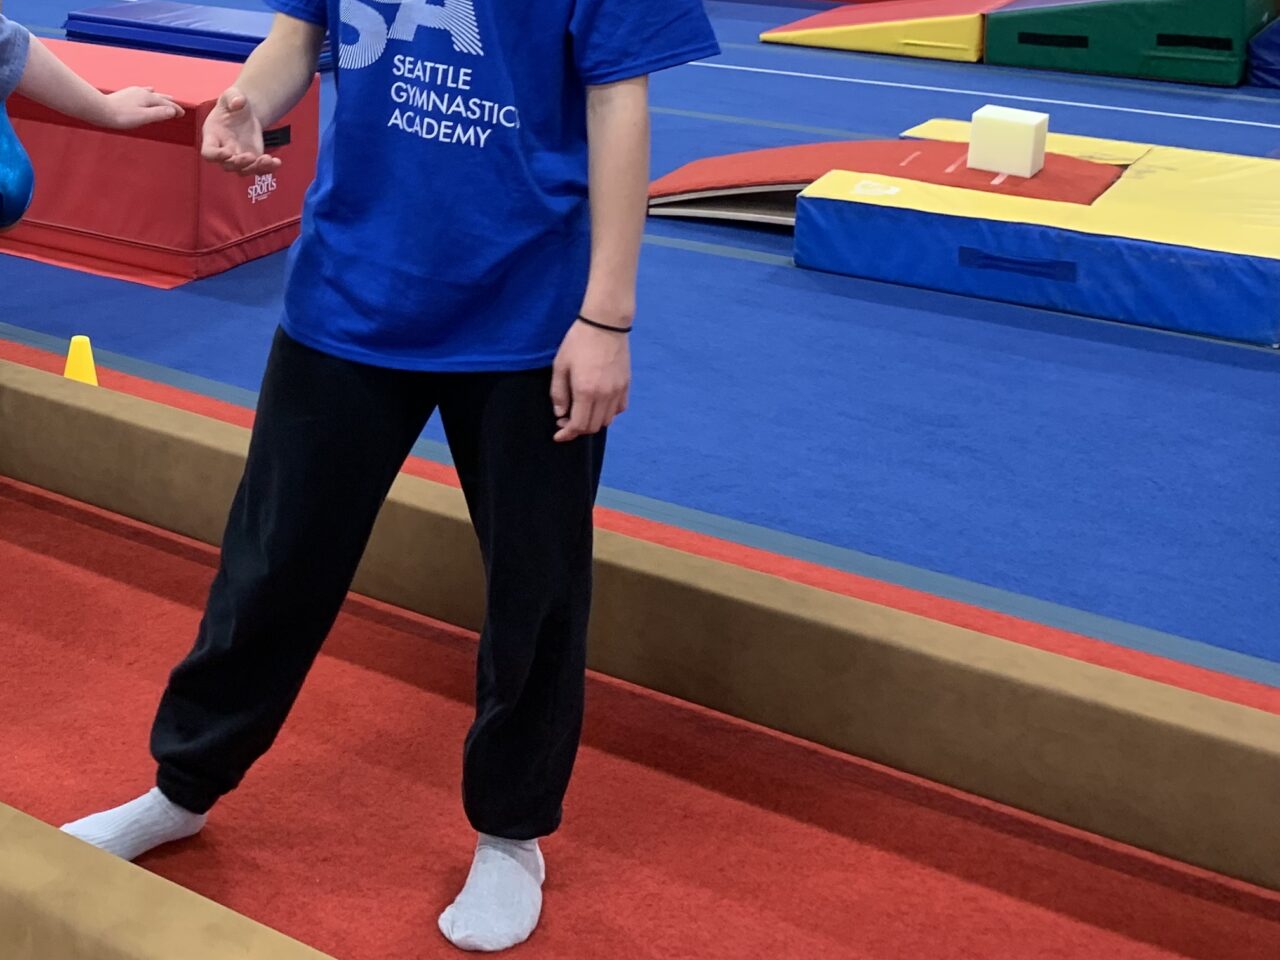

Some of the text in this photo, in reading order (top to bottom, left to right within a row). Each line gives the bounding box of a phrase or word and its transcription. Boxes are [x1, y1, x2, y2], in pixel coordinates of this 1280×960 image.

[392, 54, 472, 91] SEATTLE
[387, 108, 492, 148] ACADEMY
[247, 178, 277, 204] sports
